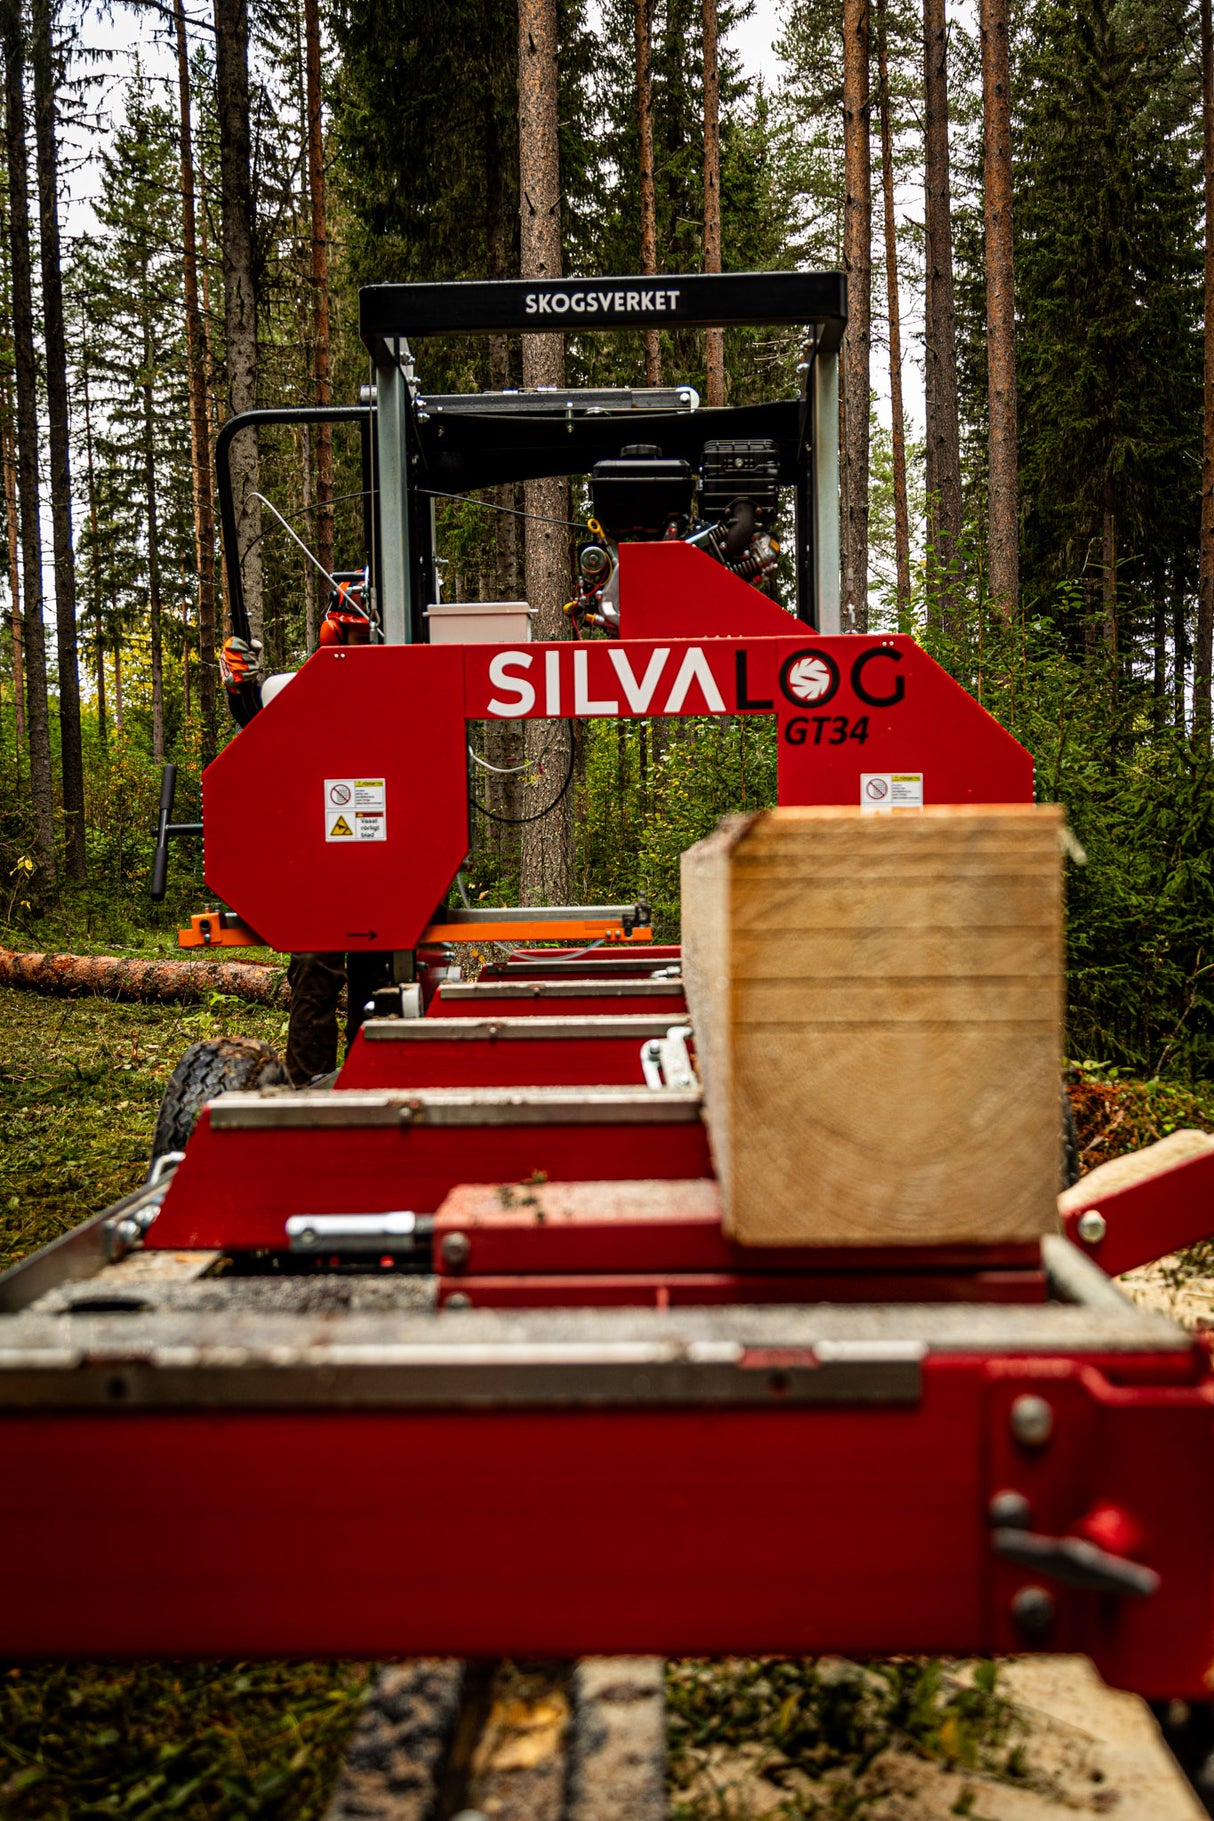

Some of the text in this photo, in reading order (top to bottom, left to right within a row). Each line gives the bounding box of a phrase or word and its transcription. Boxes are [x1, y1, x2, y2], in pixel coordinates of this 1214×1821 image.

[525, 290, 680, 313] SKOGSVERKET
[487, 646, 906, 718] SILVALOG
[784, 716, 870, 746] GT34
